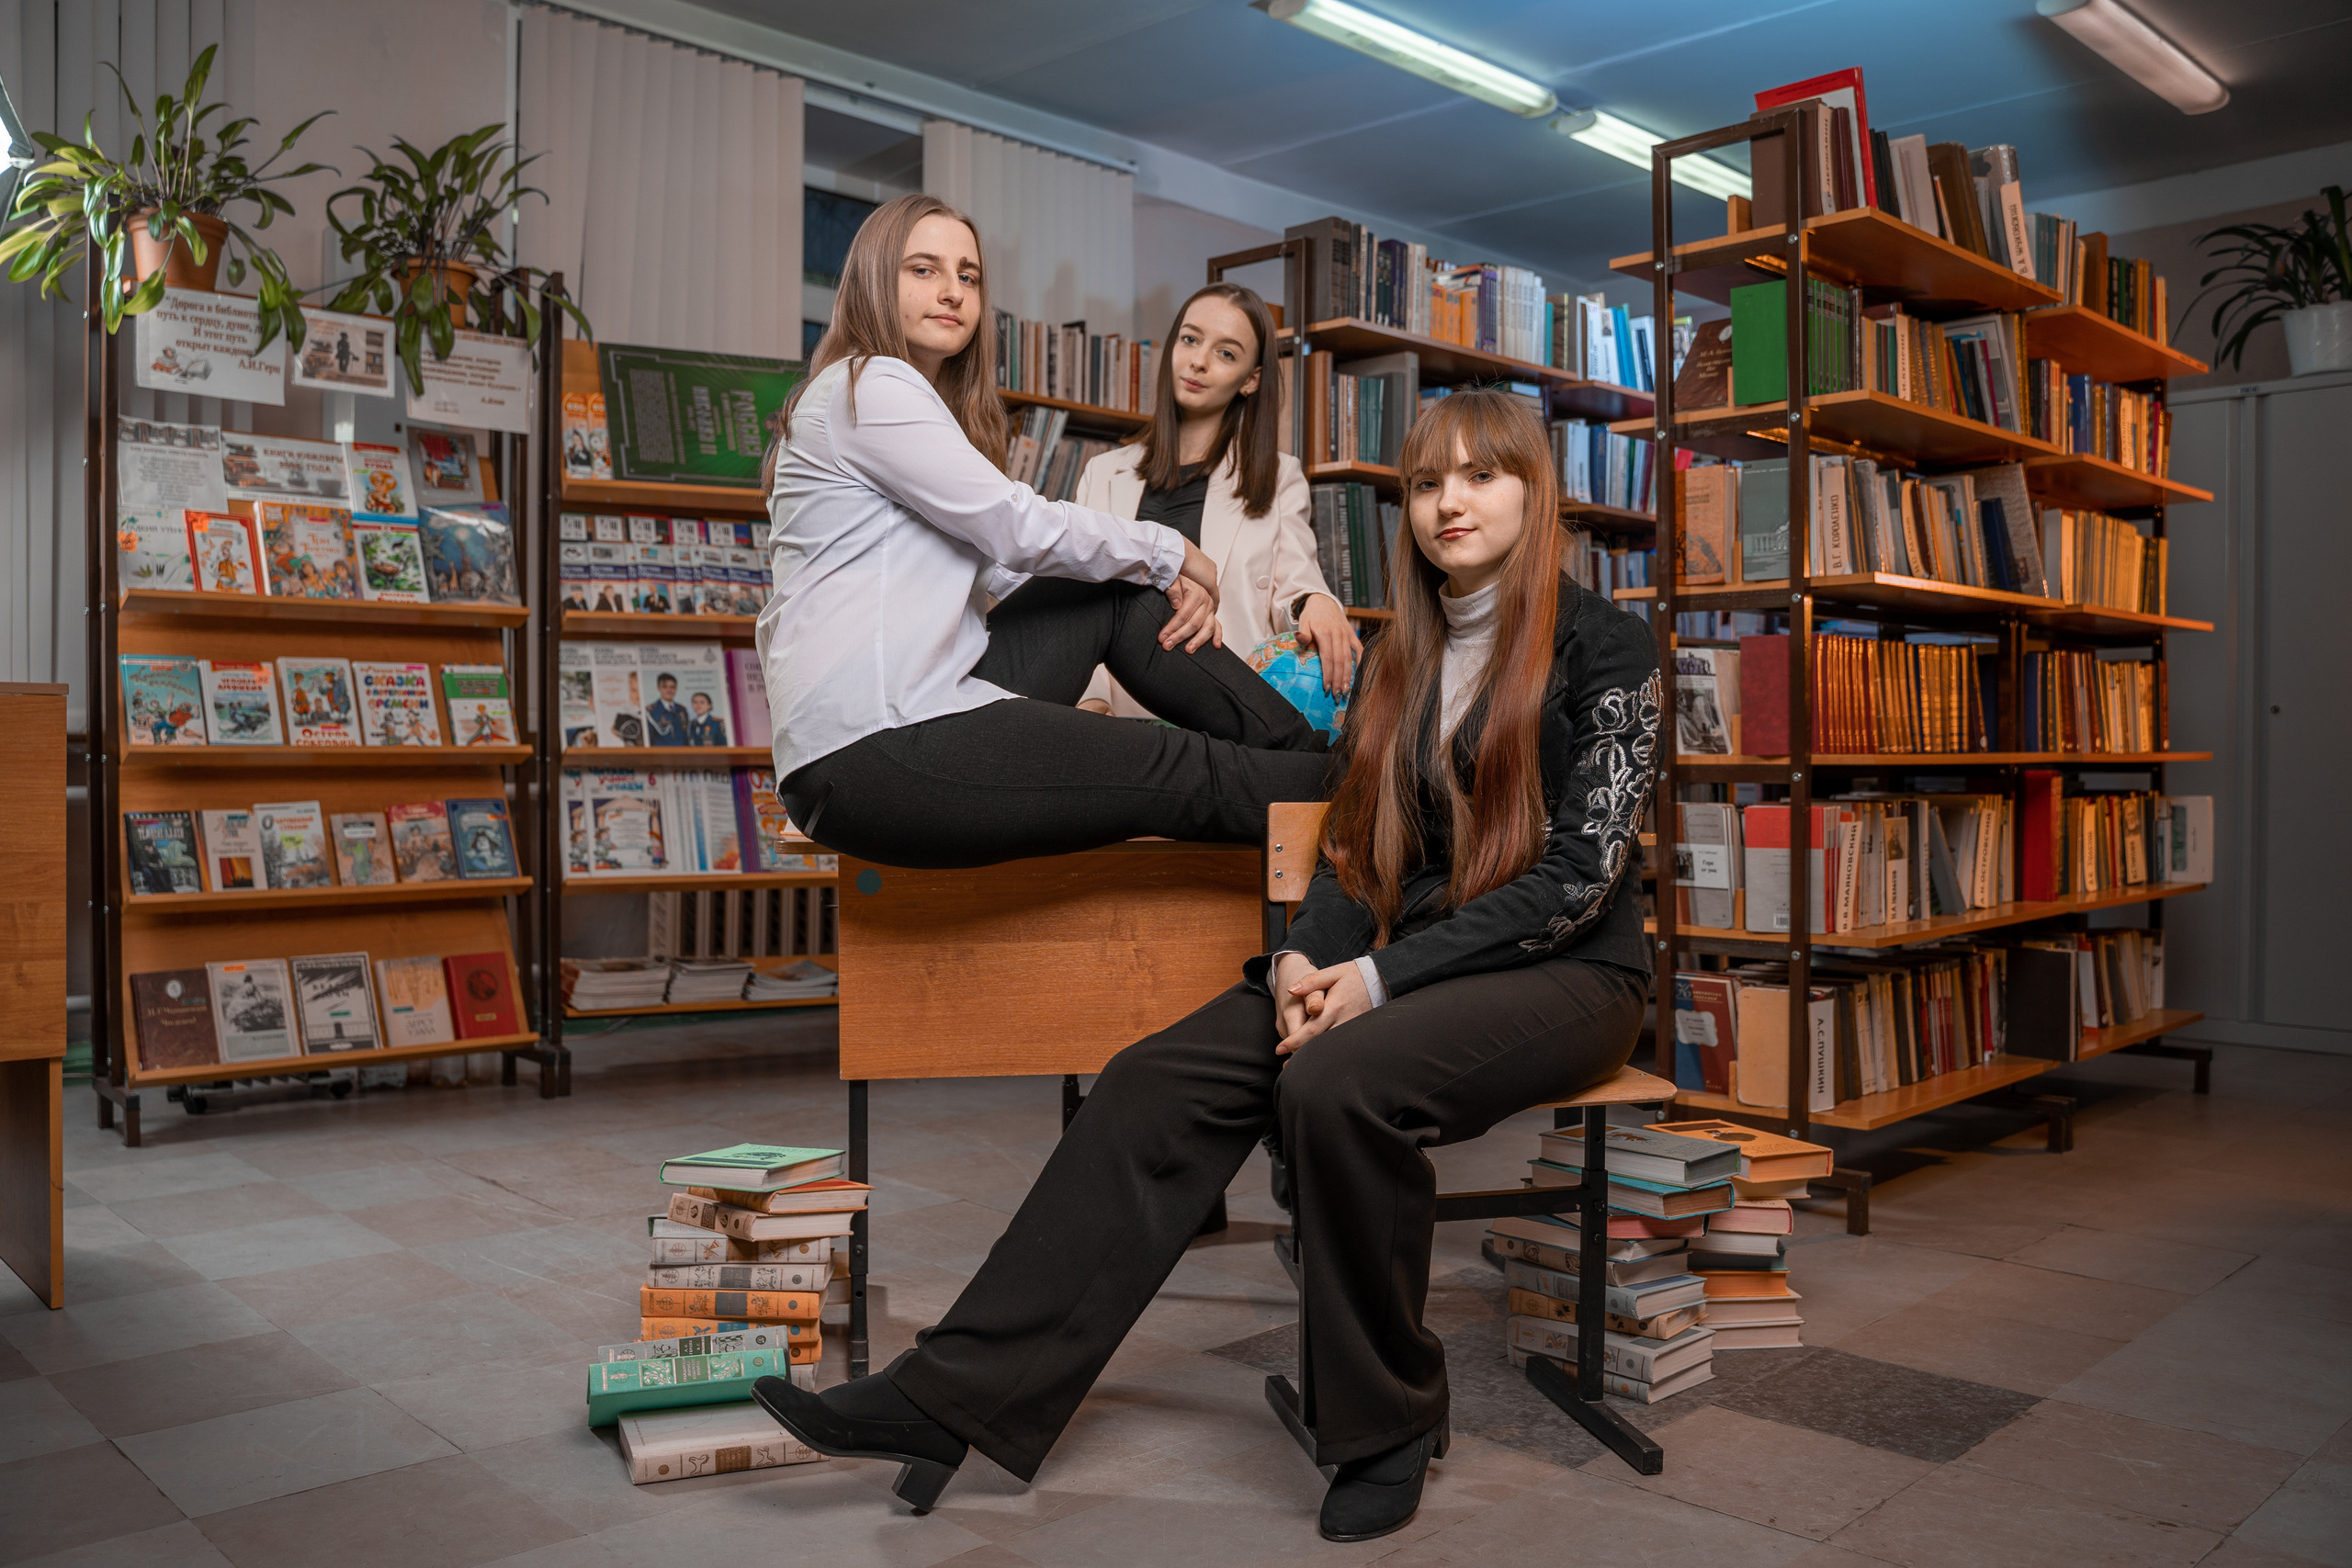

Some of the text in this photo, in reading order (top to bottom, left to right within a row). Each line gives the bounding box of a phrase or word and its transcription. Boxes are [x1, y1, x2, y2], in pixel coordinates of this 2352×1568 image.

[729, 388, 763, 457] РОССИЯ
[1830, 494, 1840, 549] КОРОЛЕНКО
[364, 675, 425, 687] СКАЗКА
[648, 772, 657, 786] 6
[1816, 1018, 1825, 1094] А.С.ПУШКИН
